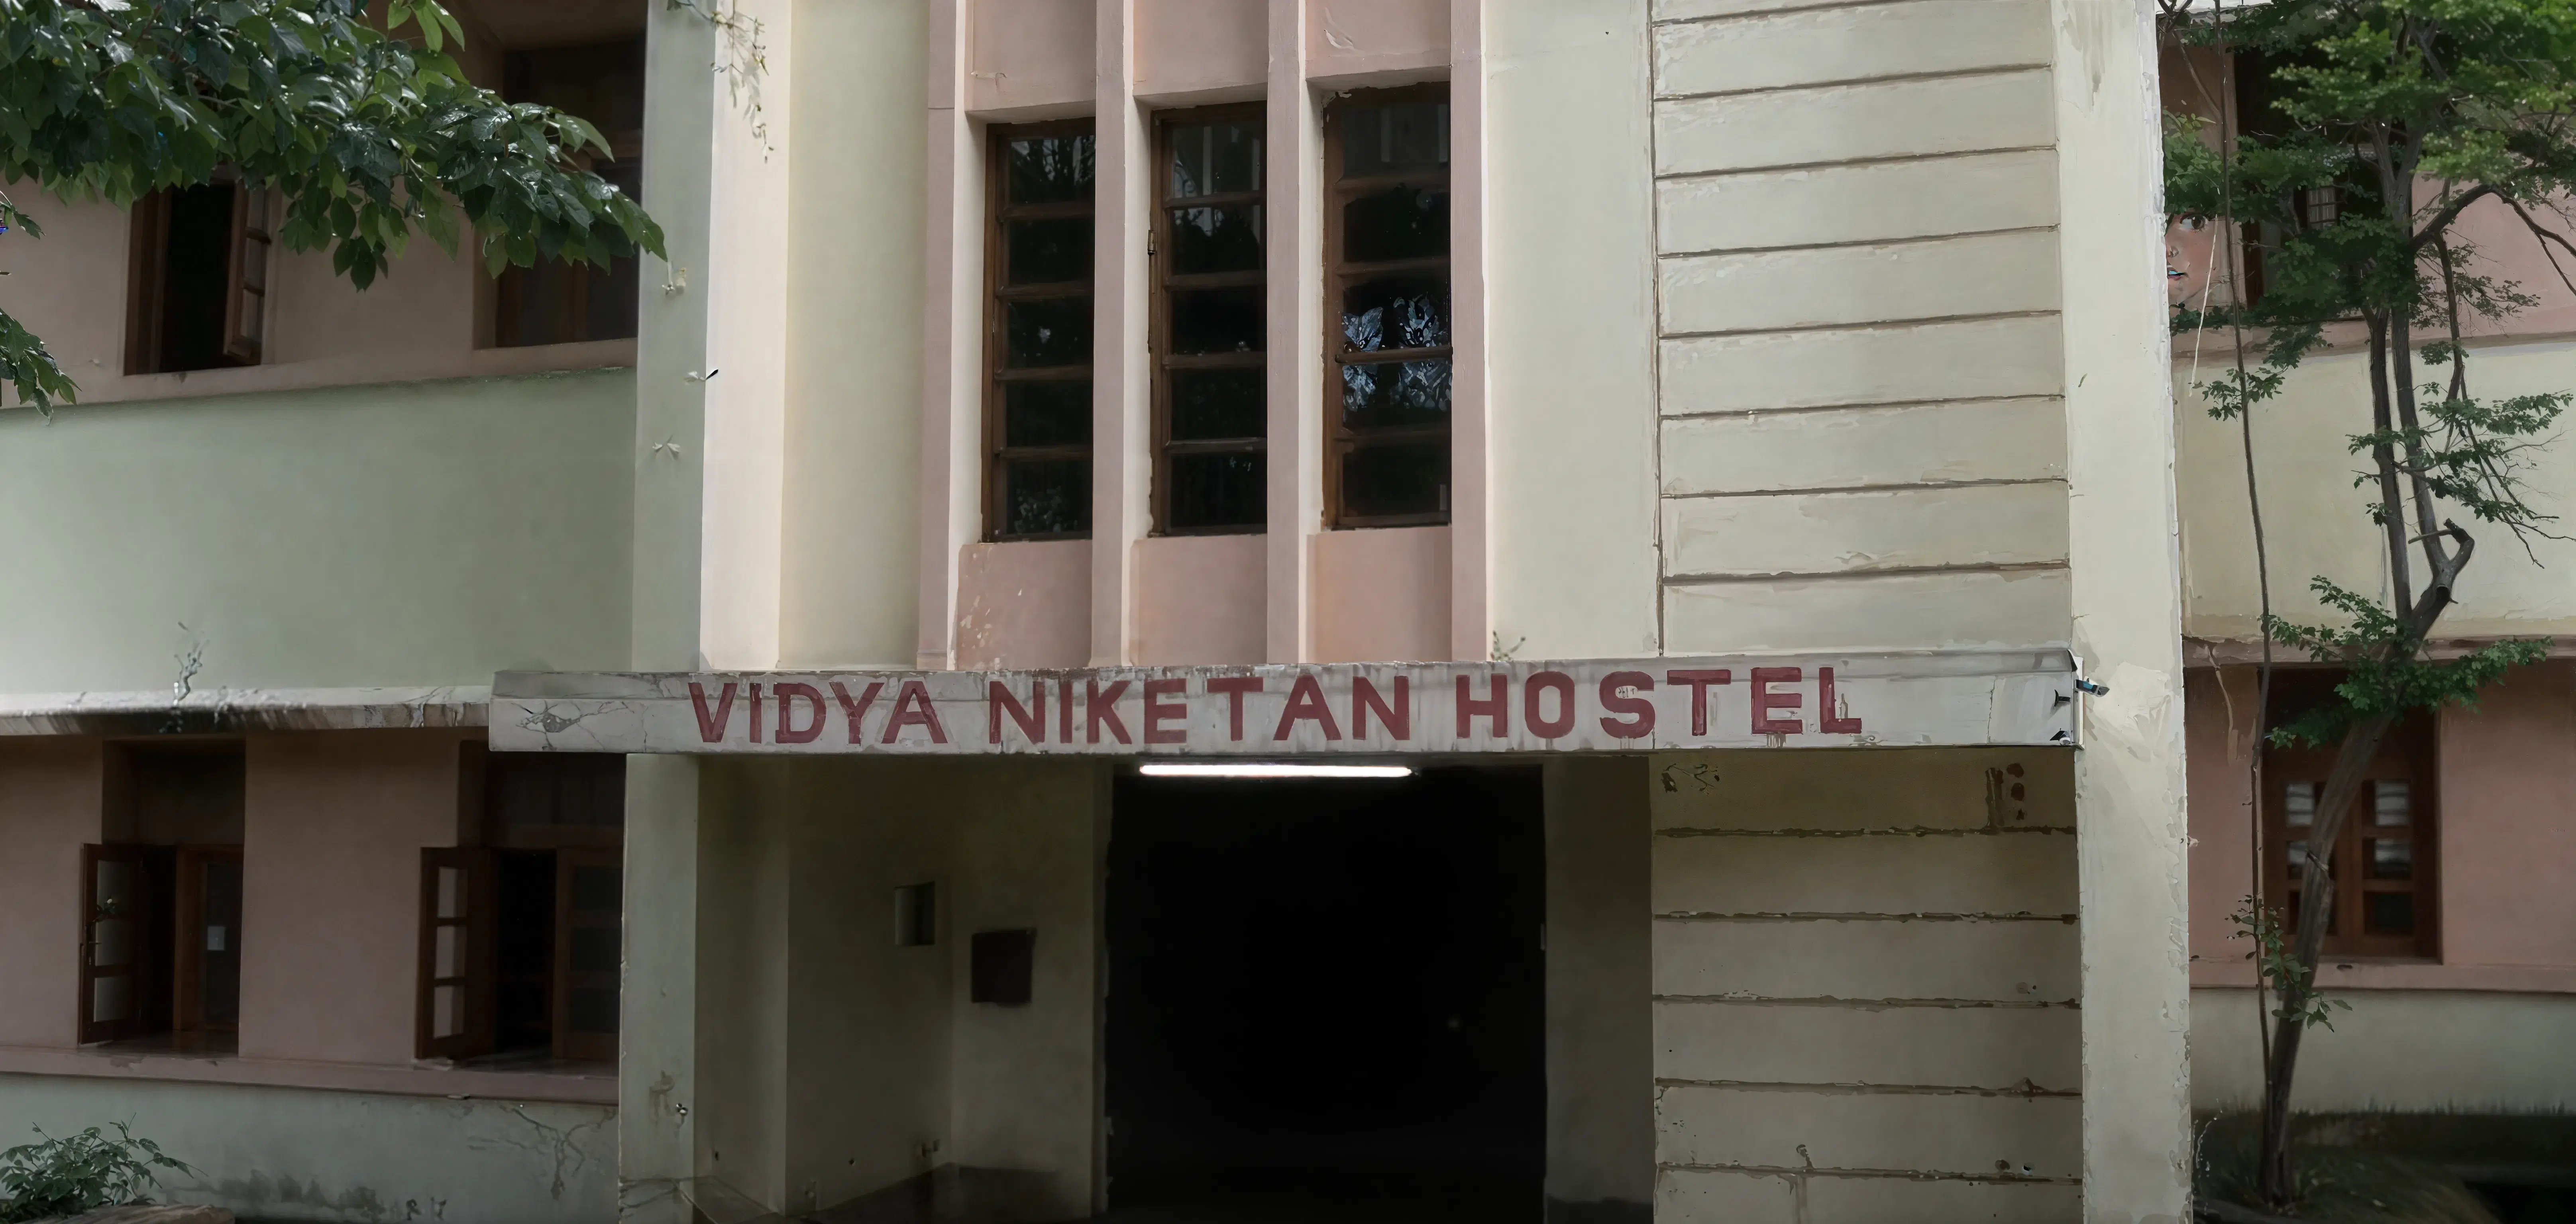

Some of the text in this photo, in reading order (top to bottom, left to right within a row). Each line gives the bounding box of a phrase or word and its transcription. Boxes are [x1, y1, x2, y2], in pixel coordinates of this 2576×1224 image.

[689, 667, 1861, 745] VIDYA NIKETAN HOSTEL
